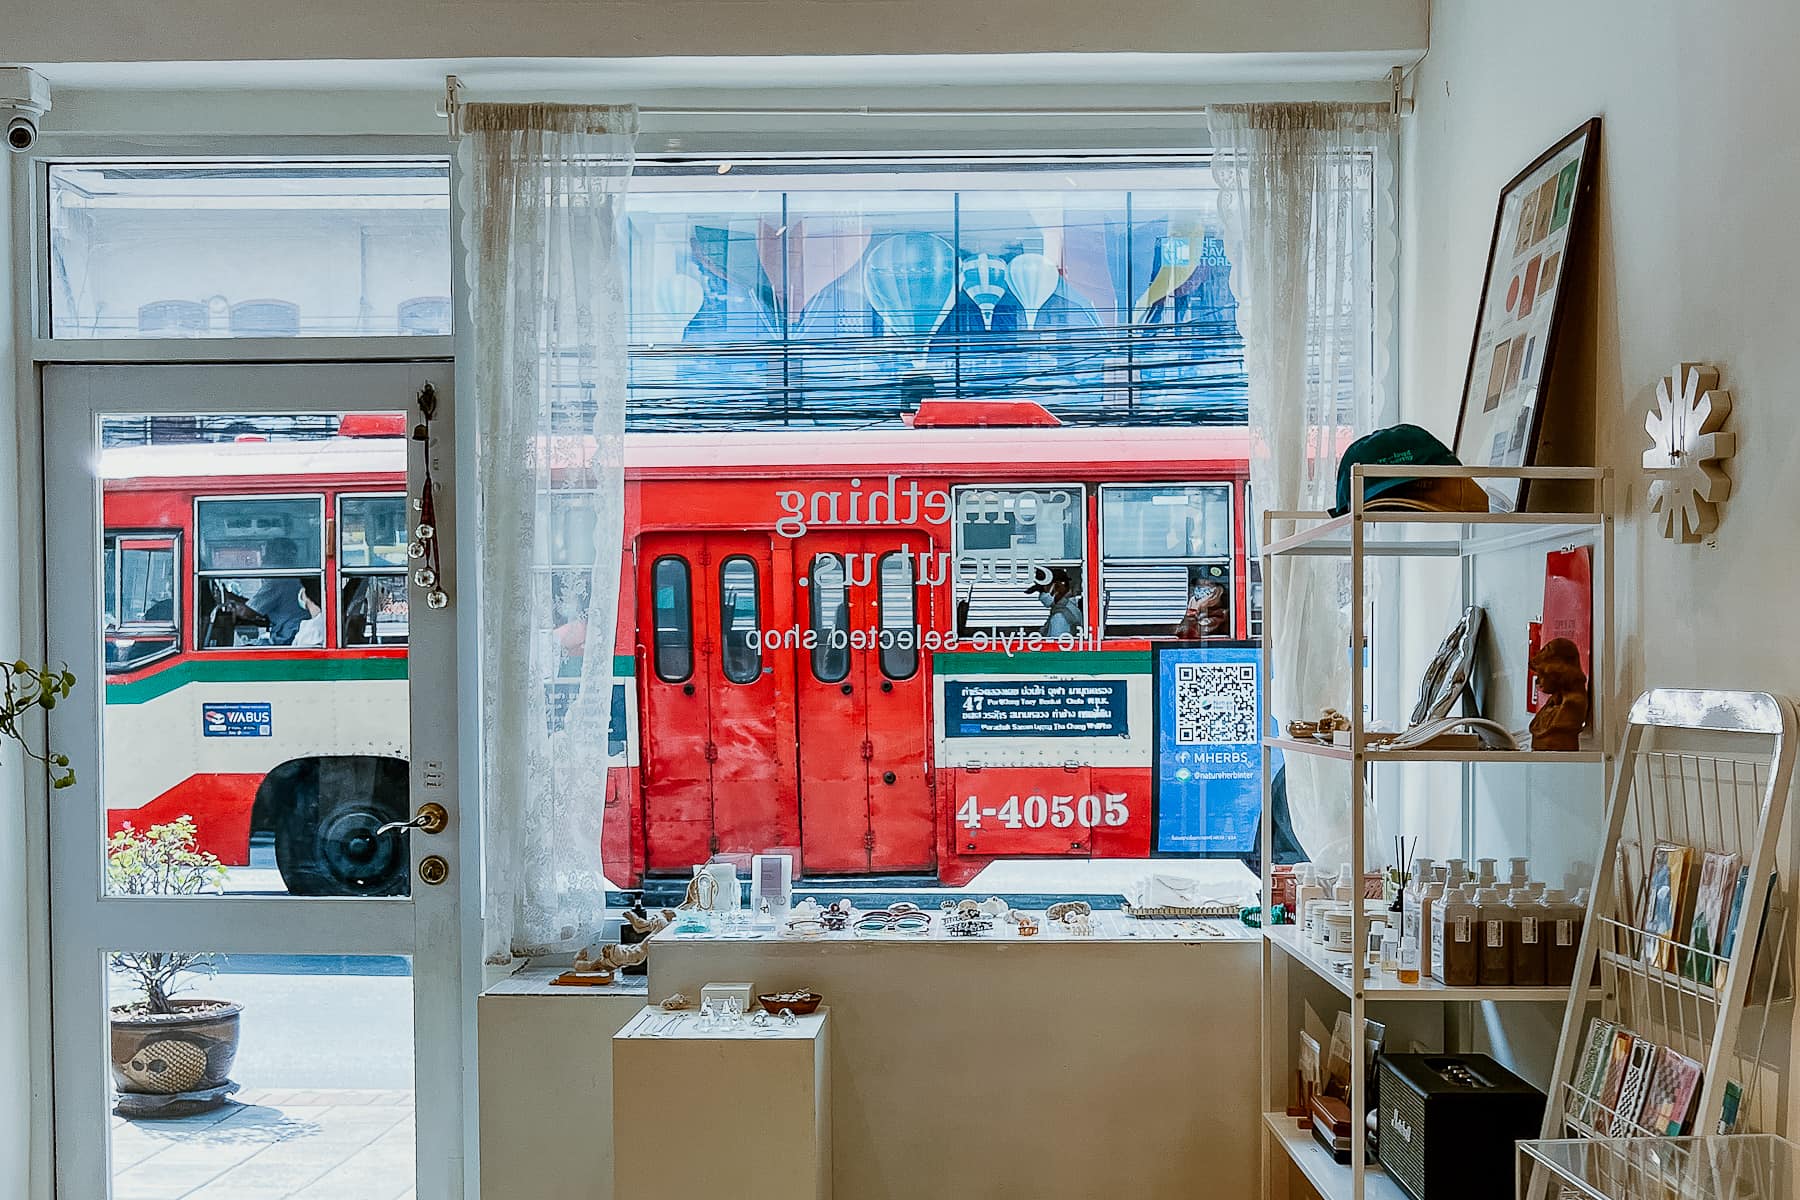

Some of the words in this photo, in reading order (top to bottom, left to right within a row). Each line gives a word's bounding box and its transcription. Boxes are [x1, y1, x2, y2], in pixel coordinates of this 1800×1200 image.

[962, 696, 984, 712] 47
[1194, 752, 1248, 764] MHERBS
[956, 792, 1130, 829] 4-40505
